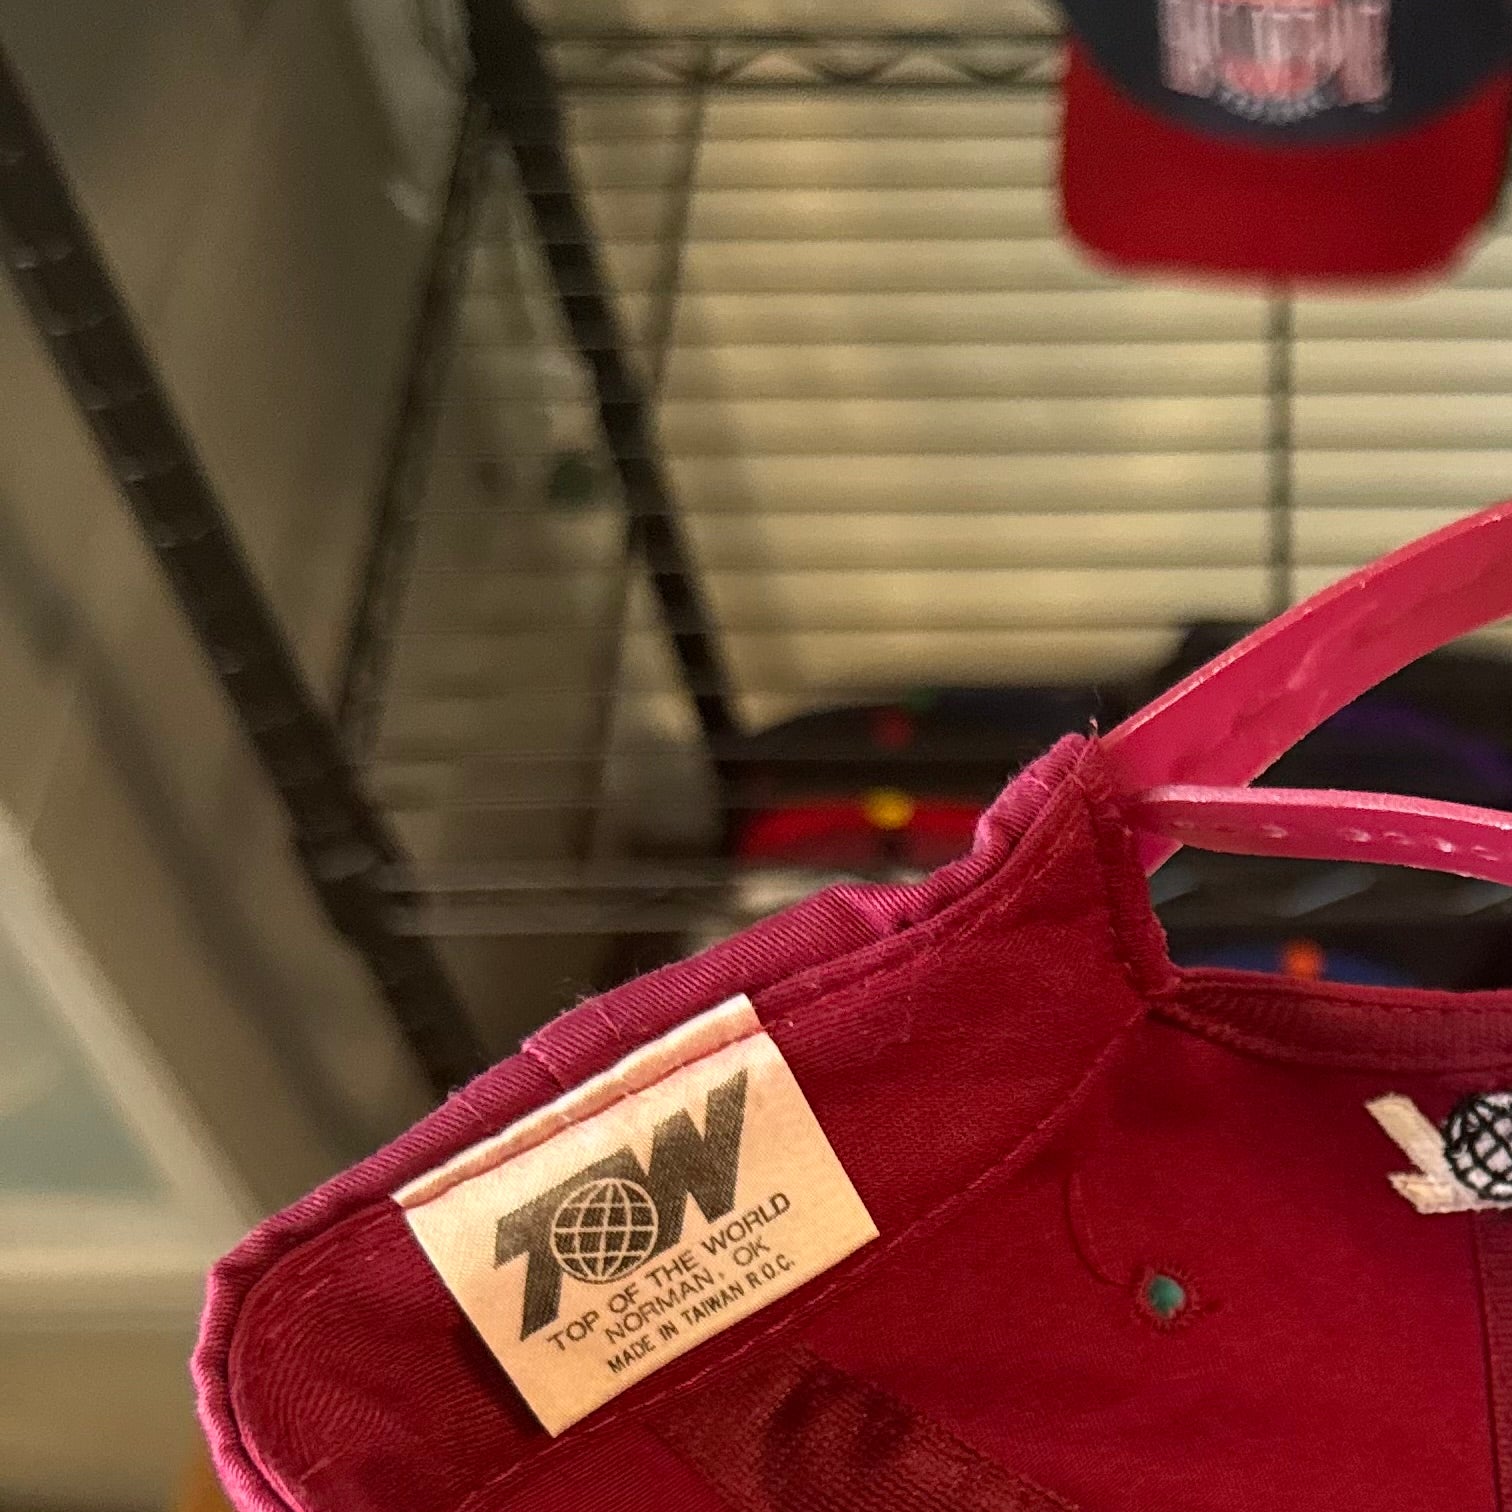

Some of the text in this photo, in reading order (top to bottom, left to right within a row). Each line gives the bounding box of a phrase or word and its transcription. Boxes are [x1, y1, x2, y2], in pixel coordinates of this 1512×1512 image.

[546, 1192, 790, 1351] TOP OF THE WORLD
[733, 1236, 770, 1266] OK
[607, 1334, 656, 1374] MADE
[659, 1320, 679, 1341] IN
[681, 1281, 745, 1326] TAIWAN
